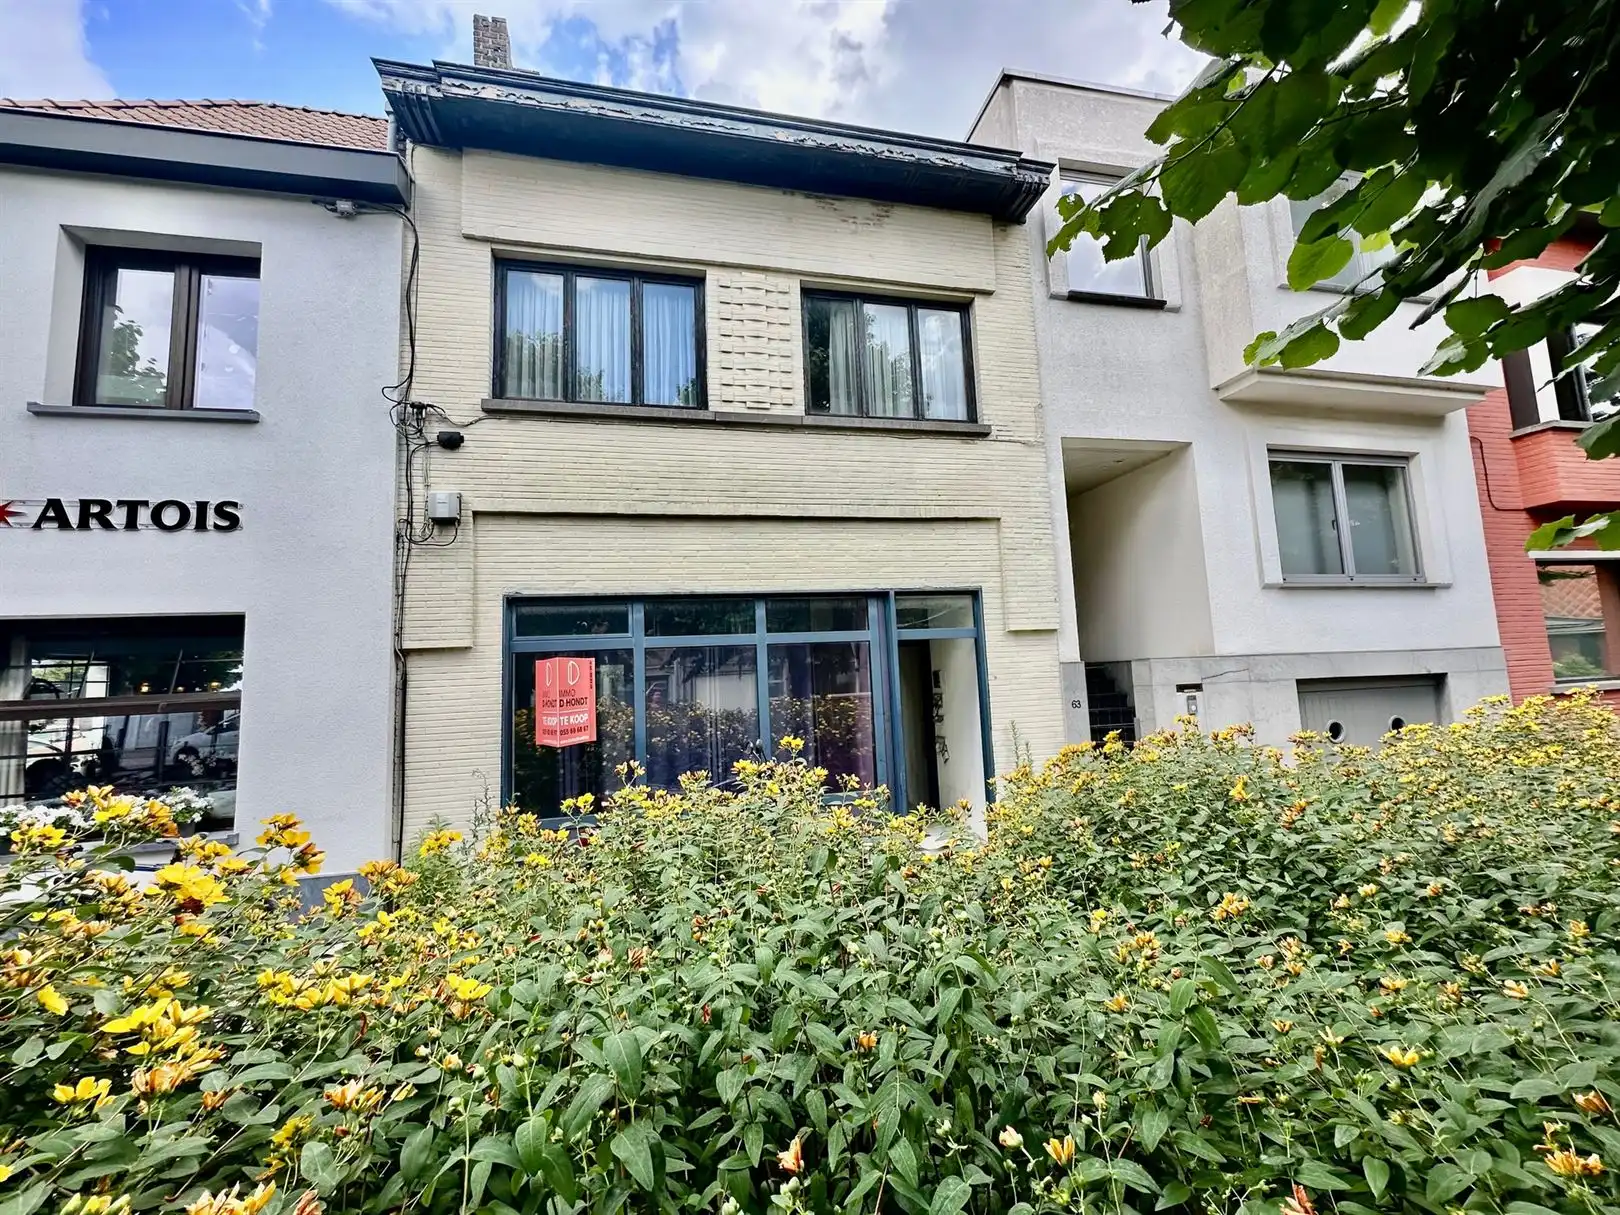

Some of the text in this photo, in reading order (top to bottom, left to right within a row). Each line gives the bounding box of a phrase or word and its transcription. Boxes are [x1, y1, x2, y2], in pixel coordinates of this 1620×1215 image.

[31, 498, 241, 532] ARTOIS
[559, 689, 576, 698] IMMO
[566, 697, 588, 706] HONDT
[1071, 699, 1081, 709] 63
[560, 713, 589, 725] TE KOOP
